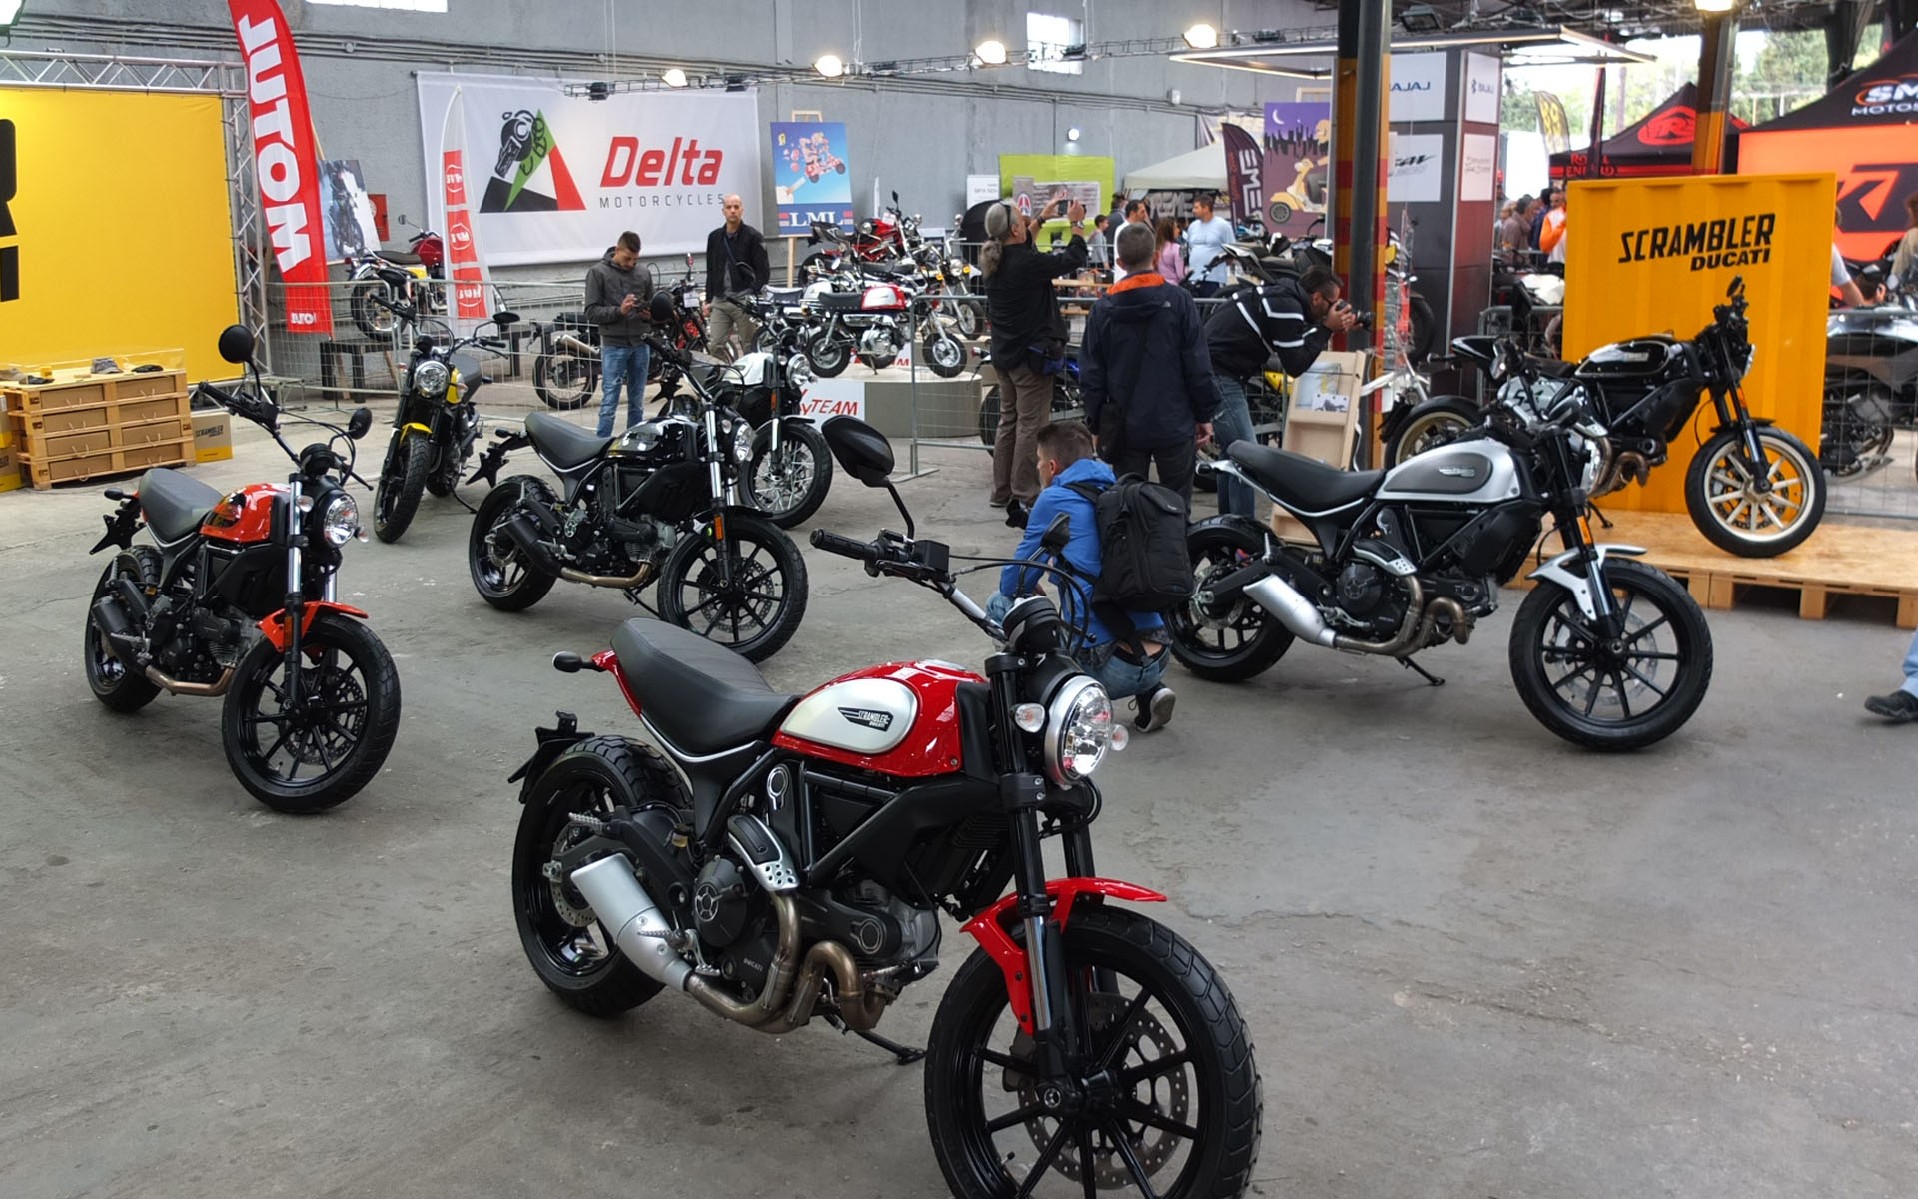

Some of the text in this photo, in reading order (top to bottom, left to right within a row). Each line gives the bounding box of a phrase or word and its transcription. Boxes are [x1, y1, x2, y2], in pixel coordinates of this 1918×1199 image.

[1389, 81, 1431, 92] AJAJ
[599, 136, 724, 188] Delta
[599, 194, 725, 208] MOTORCYCLES
[1618, 213, 1775, 263] SCRAMBLER
[1690, 248, 1771, 272] DUCATI
